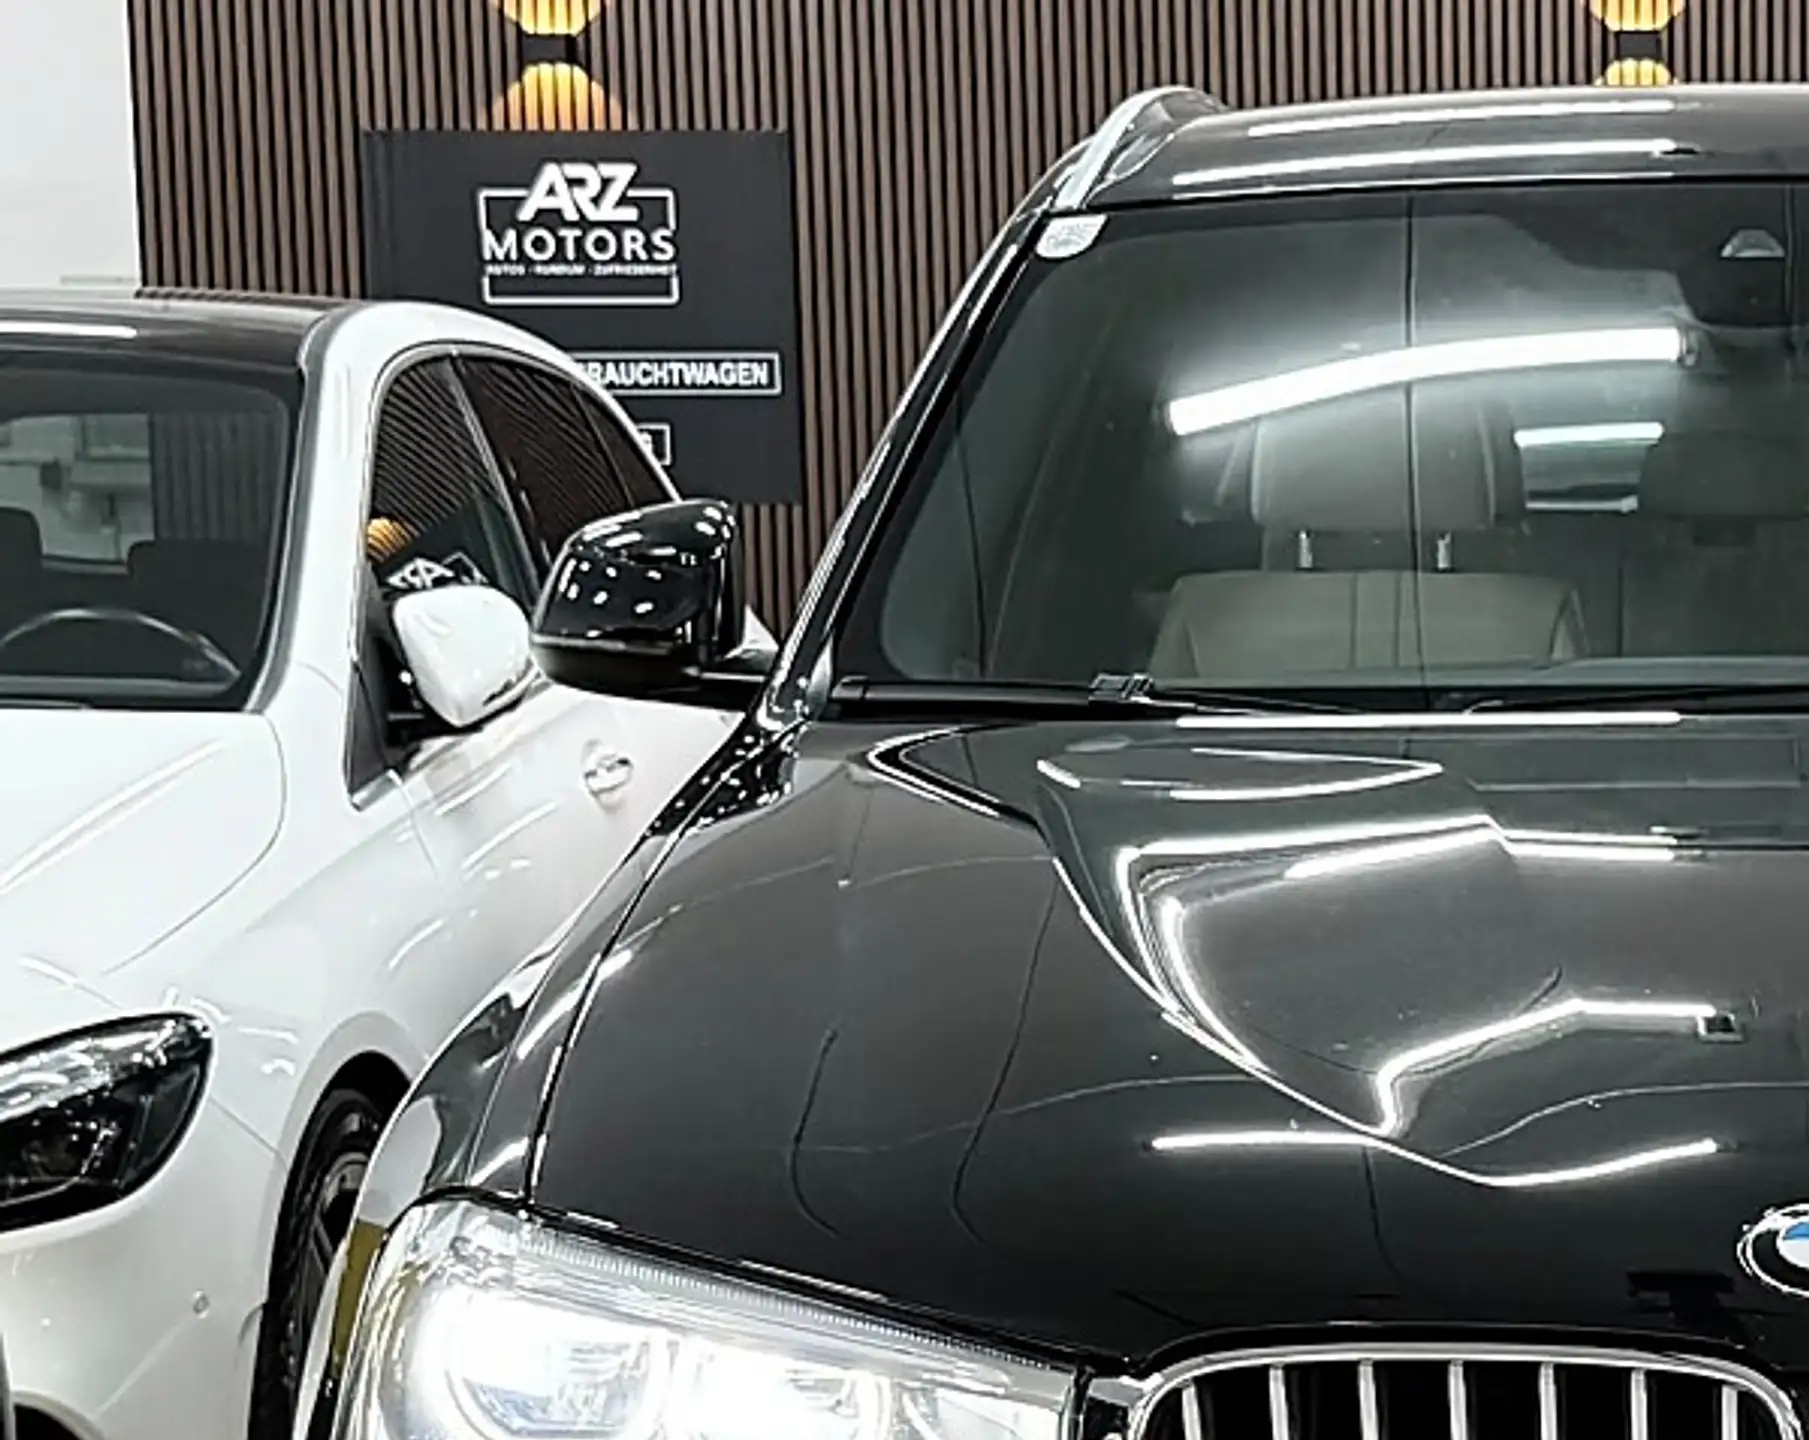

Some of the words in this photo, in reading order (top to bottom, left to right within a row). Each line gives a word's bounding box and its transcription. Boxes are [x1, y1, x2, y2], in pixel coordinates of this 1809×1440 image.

[516, 161, 638, 221] ARZ
[483, 227, 677, 261] MOTORS
[578, 361, 768, 387] RAUCHTWAGEN
